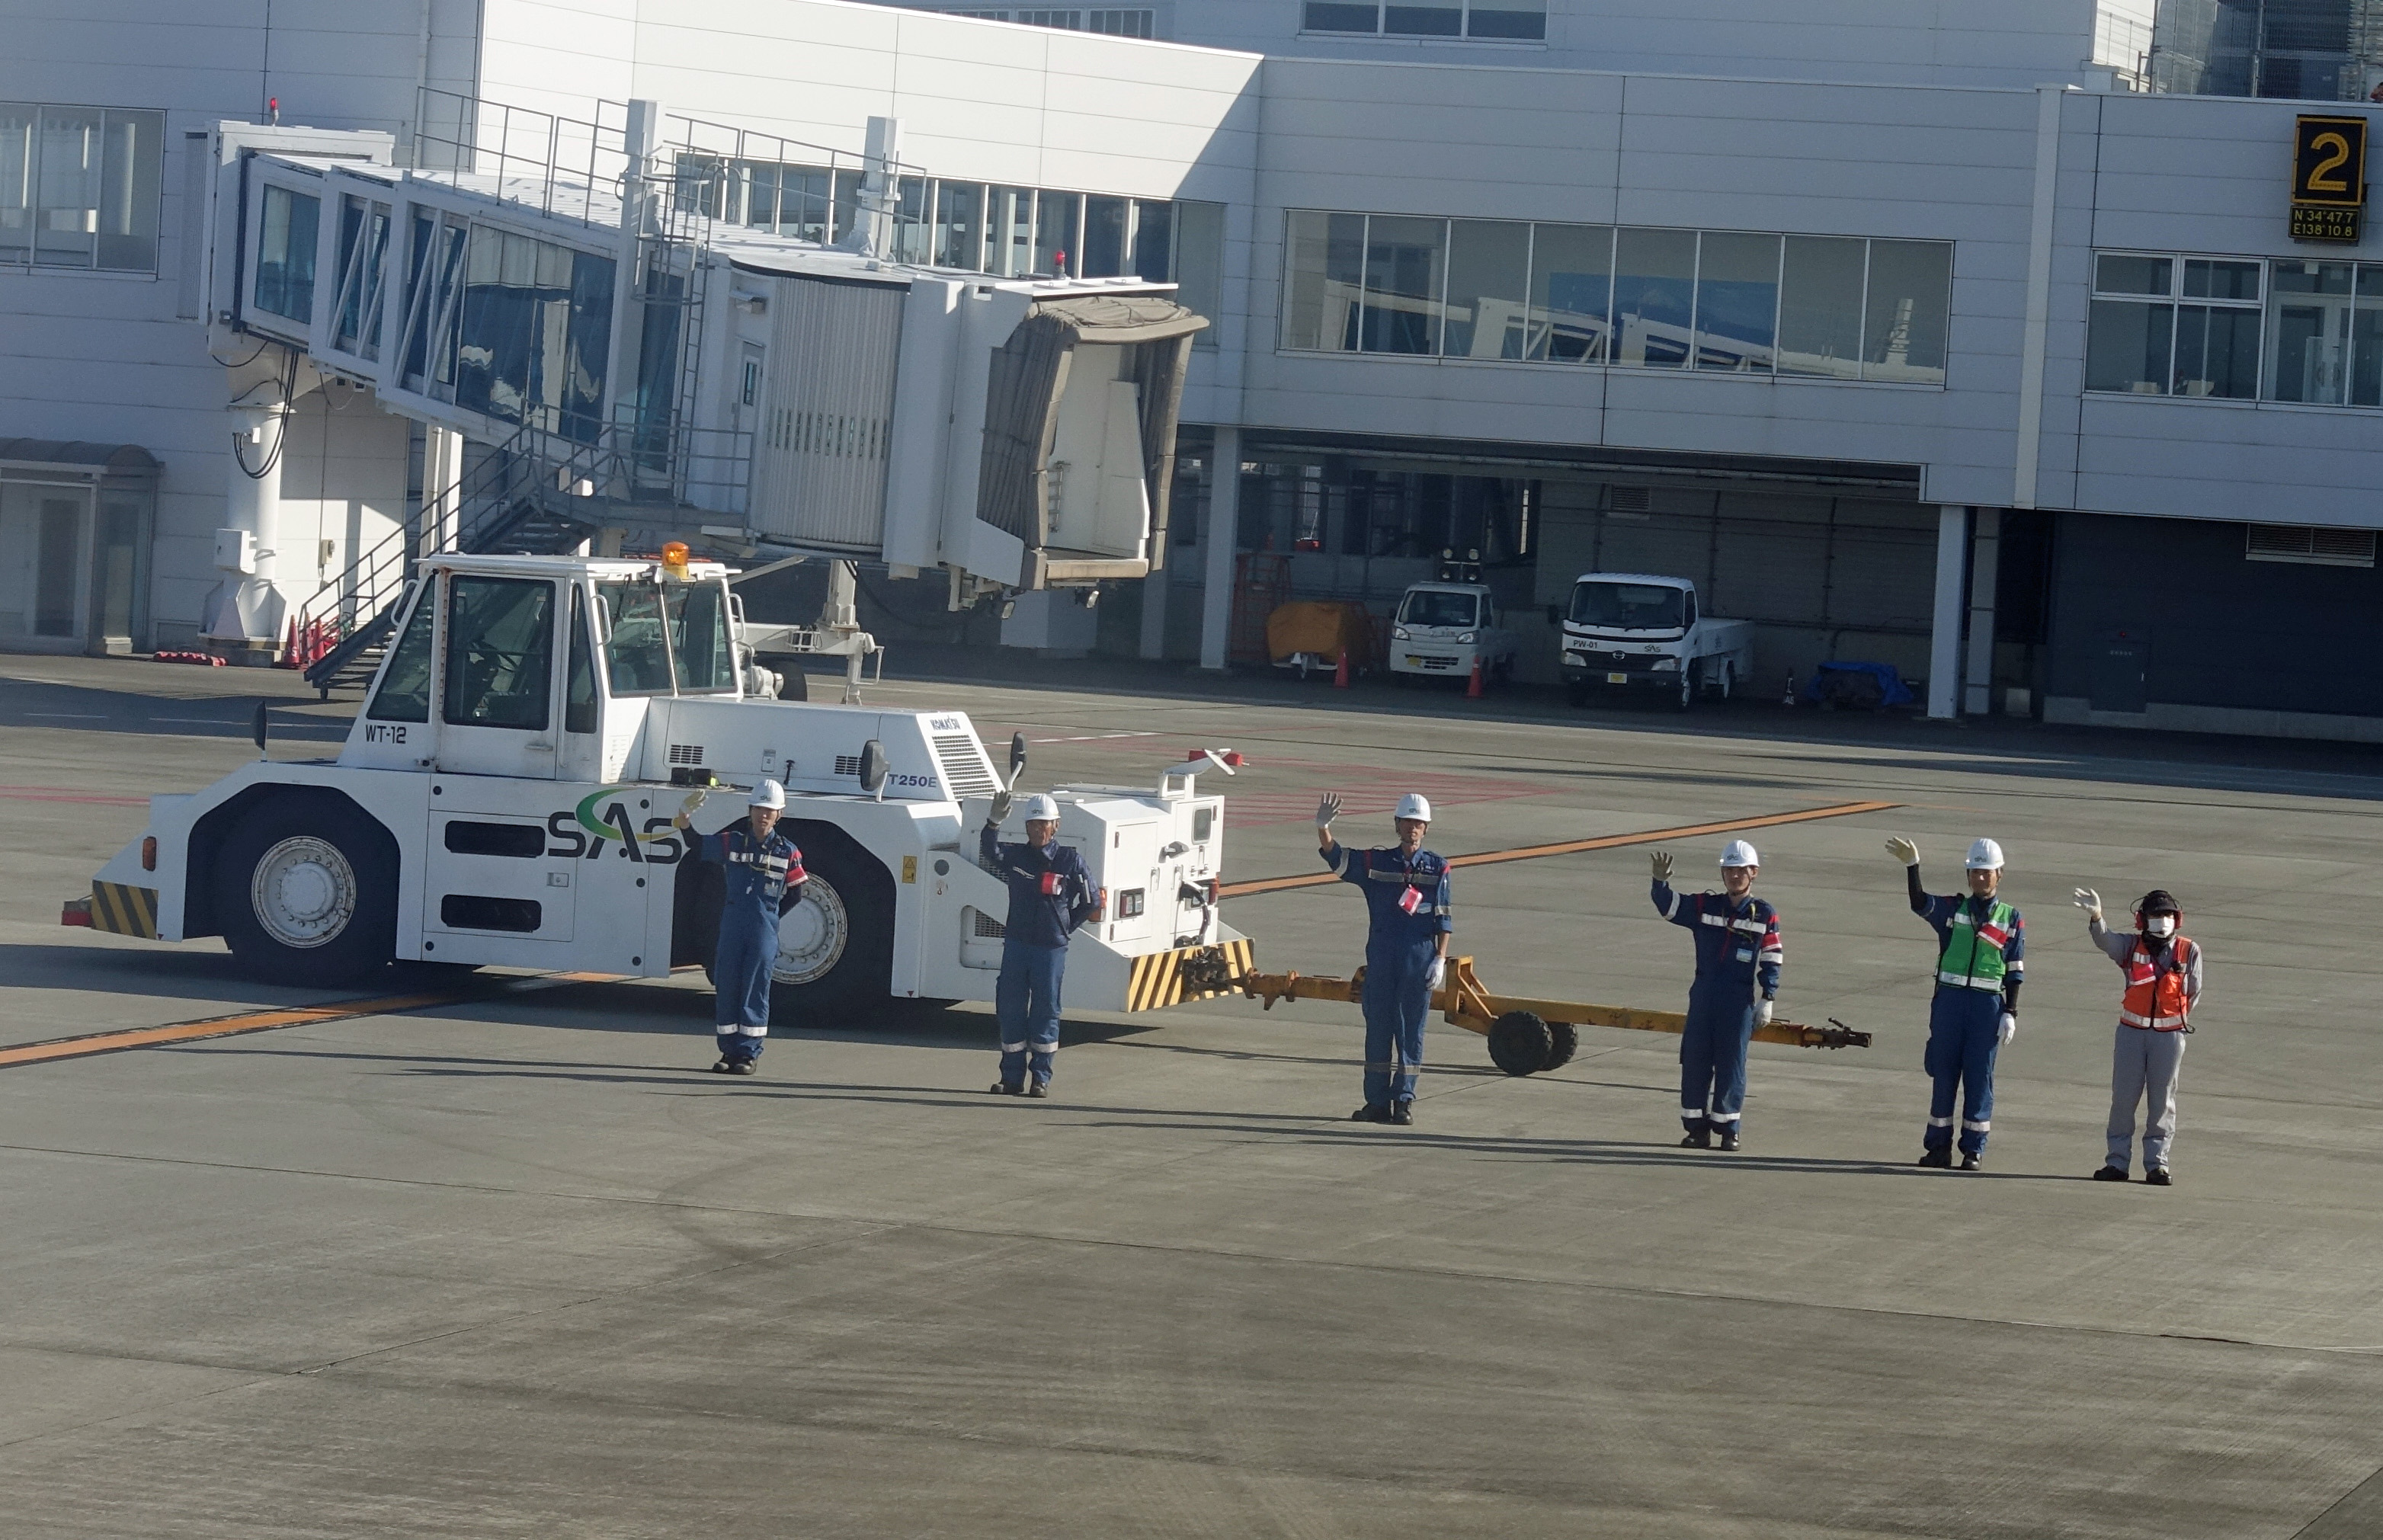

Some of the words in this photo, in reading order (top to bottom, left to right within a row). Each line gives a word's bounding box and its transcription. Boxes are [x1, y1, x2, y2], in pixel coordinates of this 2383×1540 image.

[2307, 133, 2349, 191] 2
[2295, 210, 2303, 221] N
[1573, 639, 1597, 648] PW-01
[365, 724, 407, 744] WT-12
[547, 802, 683, 865] SAS
